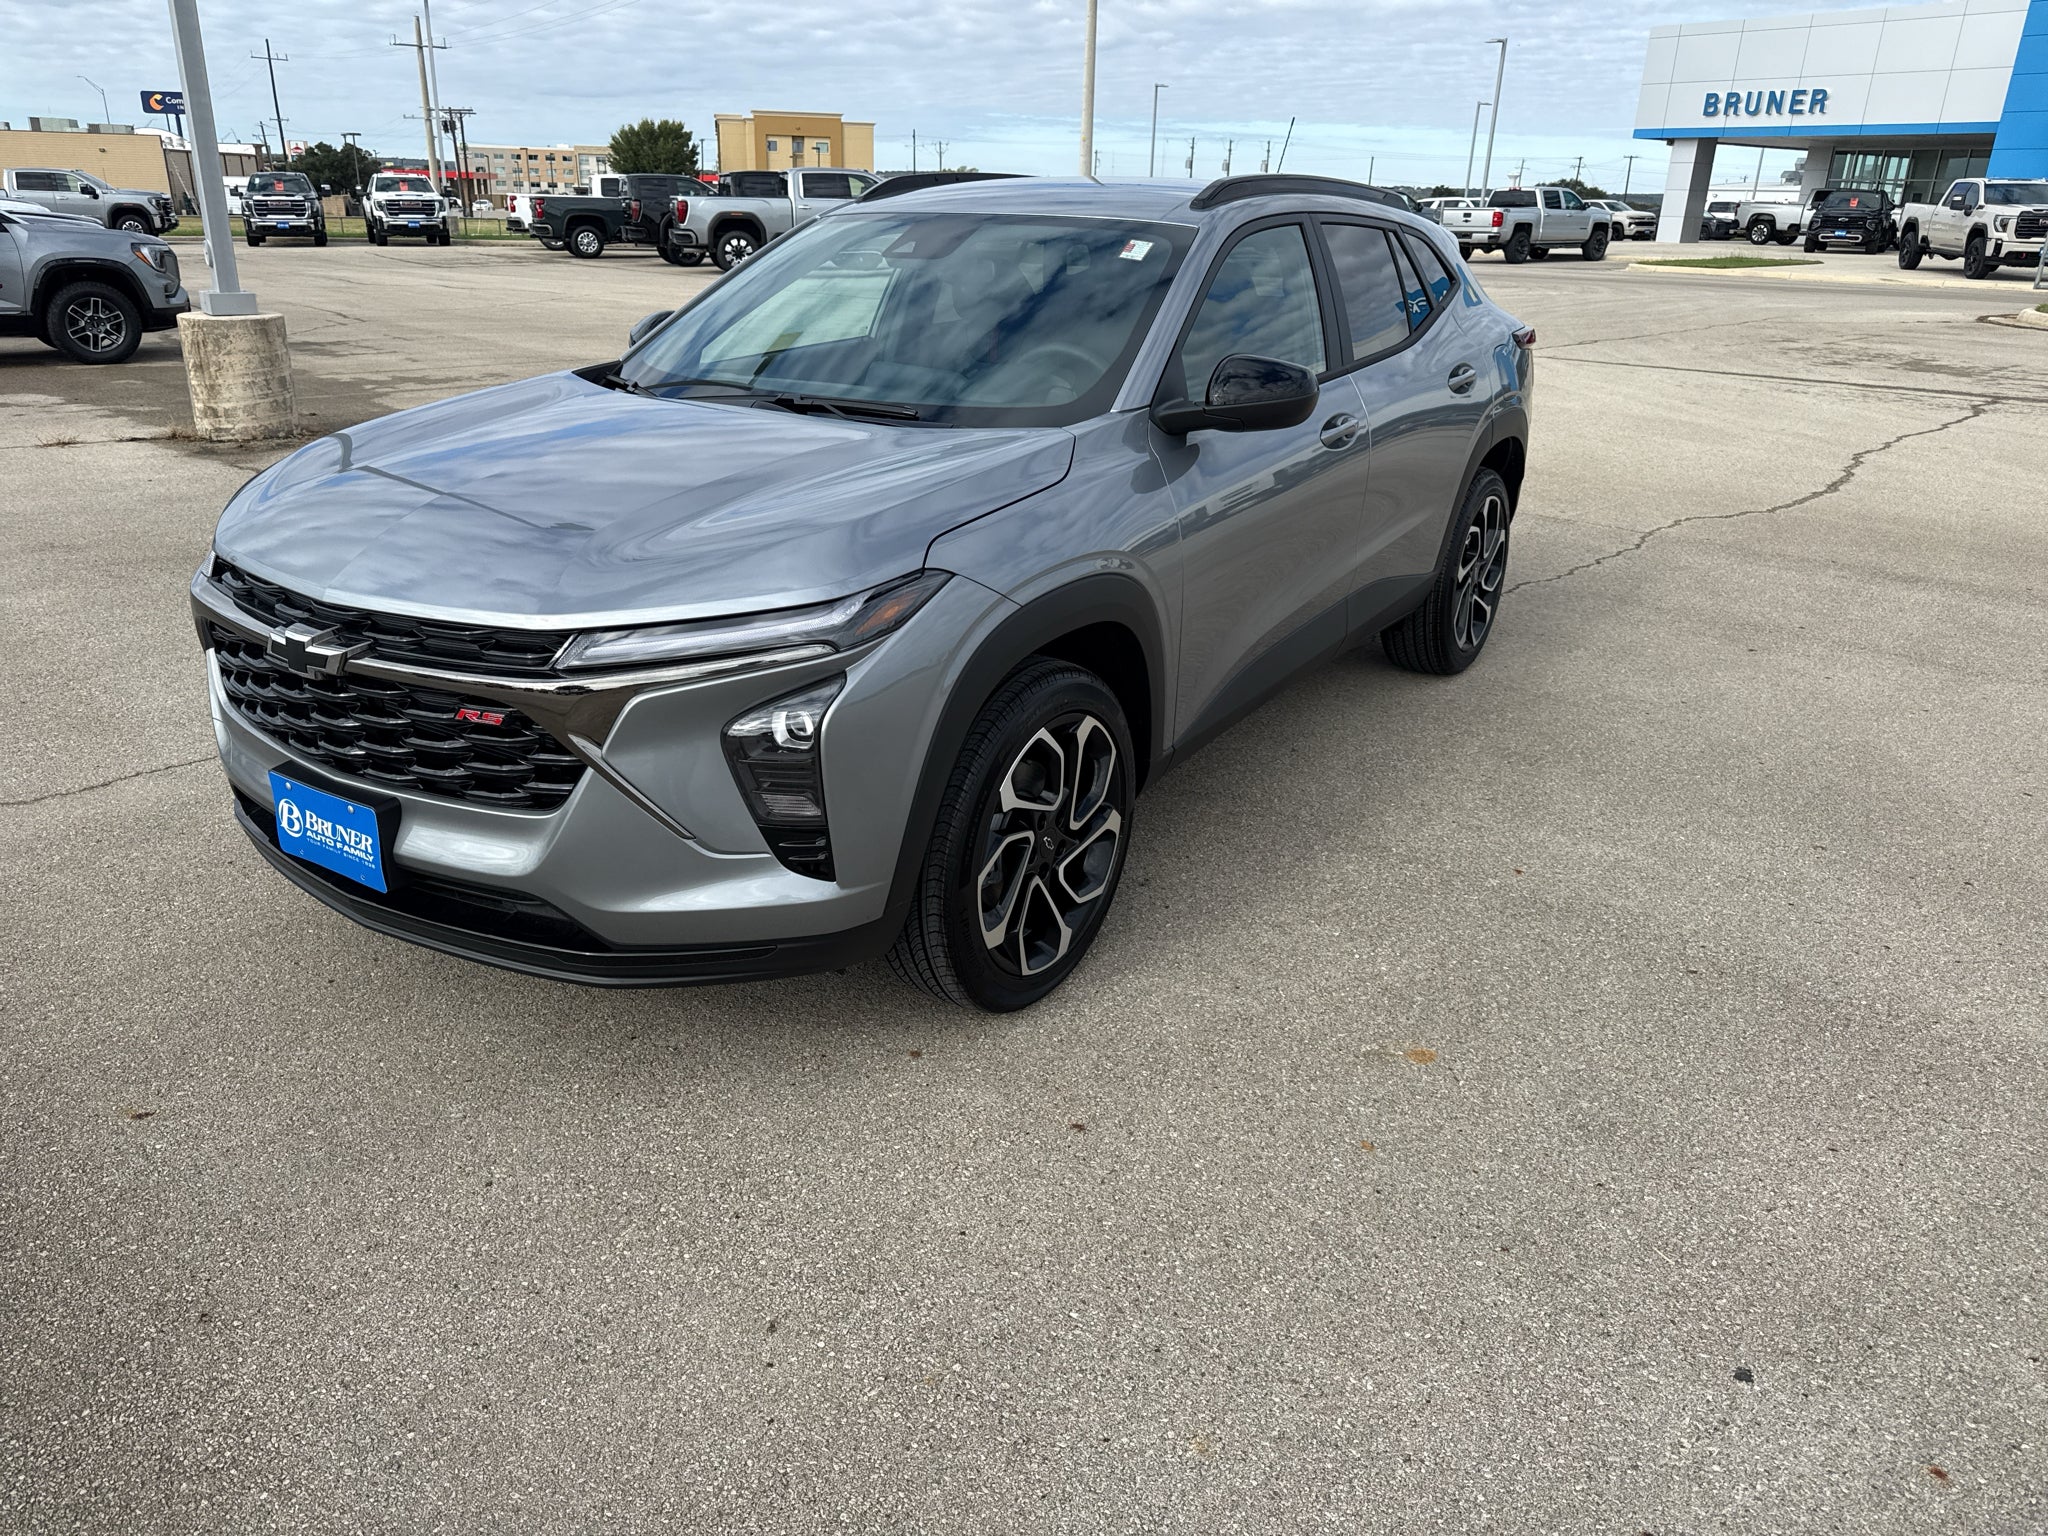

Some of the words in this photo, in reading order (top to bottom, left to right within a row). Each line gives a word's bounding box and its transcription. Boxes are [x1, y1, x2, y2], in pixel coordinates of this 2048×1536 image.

[1703, 89, 1829, 116] BRUNER
[455, 709, 504, 725] RS
[305, 810, 372, 853] BRUNER
[307, 830, 334, 846] AUTO
[337, 842, 374, 862] FAMILY
[344, 853, 359, 862] SINCE
